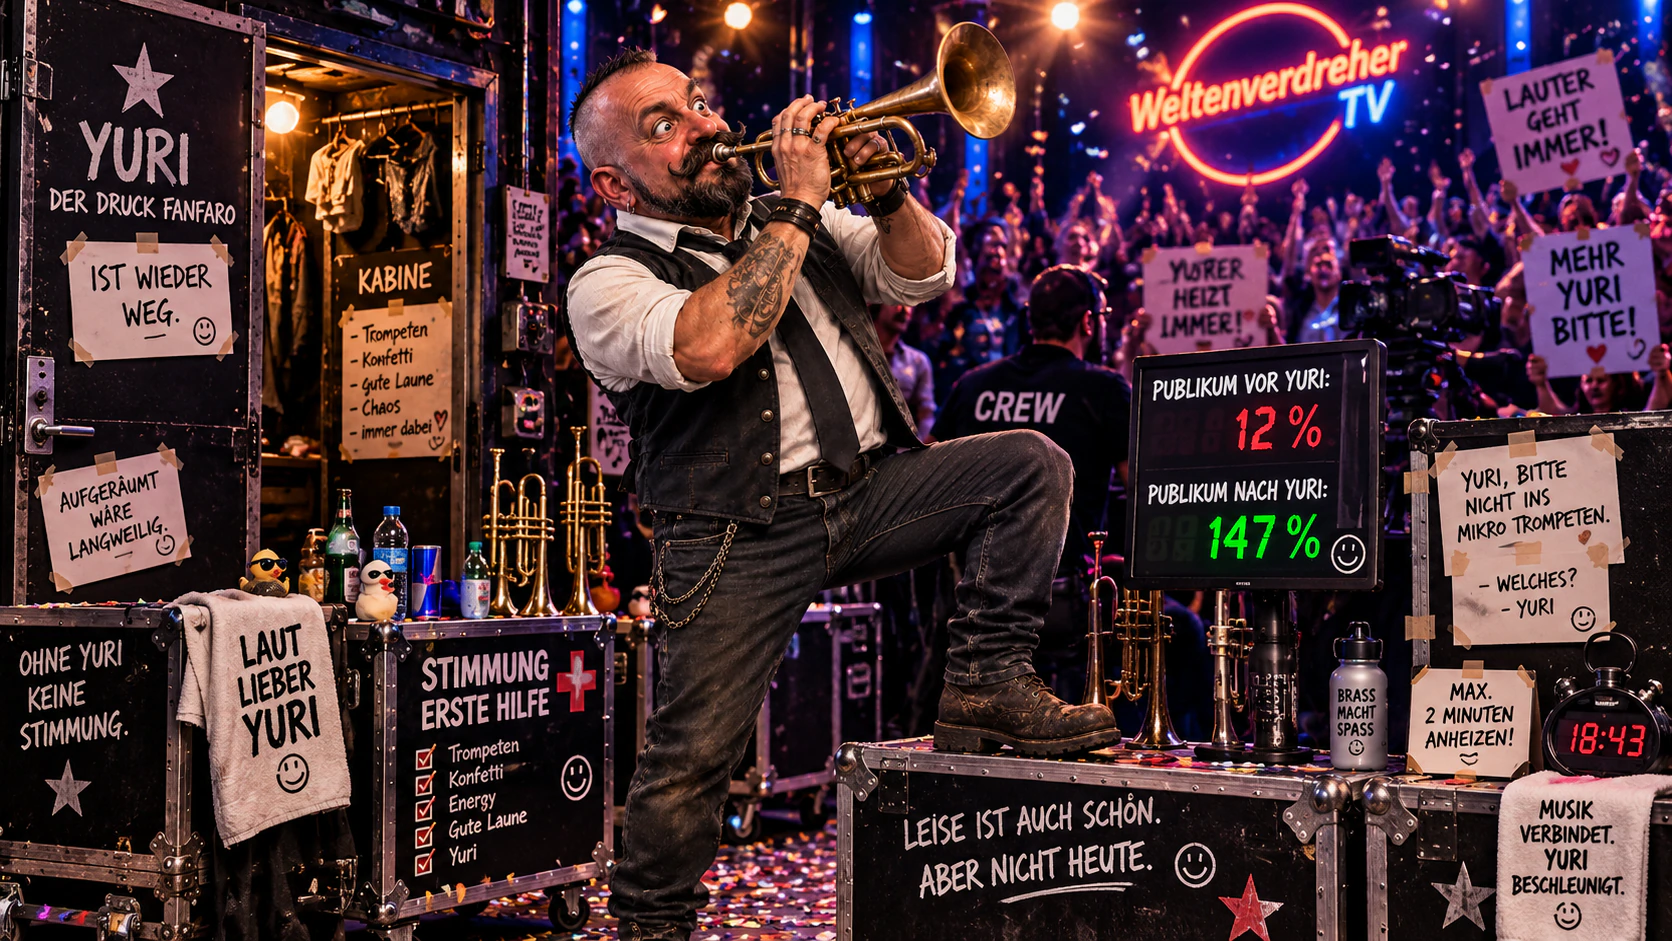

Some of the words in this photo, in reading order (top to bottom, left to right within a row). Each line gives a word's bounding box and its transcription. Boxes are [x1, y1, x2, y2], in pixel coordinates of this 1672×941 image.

[1129, 38, 1408, 133] Weltenverdreher
[1503, 67, 1595, 113] LAUTER
[1339, 79, 1396, 129] TV
[1526, 99, 1581, 134] GEHT
[79, 120, 189, 187] YURI
[1513, 118, 1610, 170] IMMER!
[49, 188, 88, 213] DER
[97, 191, 156, 219] DRUCK
[163, 197, 236, 225] FANFARO
[1550, 241, 1625, 276] MEHR
[91, 264, 128, 292] IST
[135, 263, 212, 289] WIEDER
[358, 261, 433, 295] KABINE
[1557, 274, 1621, 310] YURI
[1173, 284, 1232, 310] HEIZT
[122, 300, 180, 327] WEG.
[1161, 310, 1242, 339] IMMER!
[1552, 306, 1636, 345] BITTE!
[362, 321, 428, 345] Trompeten
[362, 348, 413, 369] Konfetti
[395, 372, 434, 391] Laune
[1153, 374, 1238, 401] PUBLIKUM
[1244, 373, 1277, 394] VOR
[1285, 368, 1330, 390] YURI:
[361, 398, 401, 417] Chaos
[974, 390, 1066, 424] CREW
[361, 424, 397, 440] immer
[400, 419, 432, 436] dabei
[1236, 405, 1276, 451] 12
[1288, 403, 1322, 450] %
[1148, 482, 1227, 505] PUBLIKUM
[1234, 480, 1278, 502] NACH
[1284, 477, 1328, 500] YURI:
[1461, 468, 1509, 493] YURI,
[1516, 459, 1568, 485] BITTE
[1465, 491, 1516, 517] NICHT
[1523, 488, 1551, 509] INS
[69, 516, 168, 561] LANGWEILIG.
[1208, 514, 1276, 560] 147
[1287, 513, 1321, 559] %
[1457, 521, 1507, 543] MIKRO
[1512, 505, 1610, 535] TROMPETEN.
[1496, 567, 1578, 592] WELCHES?
[1516, 598, 1554, 619] YURI
[19, 644, 71, 677] OHNE
[79, 639, 122, 667] YURI
[239, 623, 301, 669] LAUT
[237, 660, 316, 708] LIEBER
[421, 649, 549, 692] STIMMUNG
[28, 680, 86, 712] KEINE
[1337, 688, 1376, 703] BRASS
[1450, 682, 1492, 701] MAX.
[421, 693, 489, 731] ERSTE
[497, 688, 549, 722] HILFE
[1337, 705, 1377, 720] MACHT
[1425, 706, 1435, 725] 2
[1442, 706, 1514, 724] MINUTEN
[20, 710, 129, 750] STIMMUNG.
[241, 695, 321, 757] YURI
[1337, 722, 1374, 737] SPASS
[1425, 729, 1514, 749] ANHEIZEN!
[1570, 722, 1646, 757] 18:43
[448, 739, 520, 763] Trompeten
[449, 764, 504, 788] Konfetti
[449, 792, 497, 813] Energy
[1539, 799, 1594, 820] MUSIK
[449, 819, 482, 840] Gute
[487, 810, 528, 831] Laune
[976, 806, 1010, 840] IST
[1016, 800, 1073, 836] AUCH
[1519, 825, 1615, 845] VERBINDET.
[449, 844, 477, 866] Yuri
[919, 860, 984, 899] ABER
[990, 846, 1062, 887] NICHT
[1068, 840, 1153, 882] HEUTE.
[1544, 849, 1588, 871] YURI
[1511, 875, 1625, 896] BESCHLEUNIGT.
